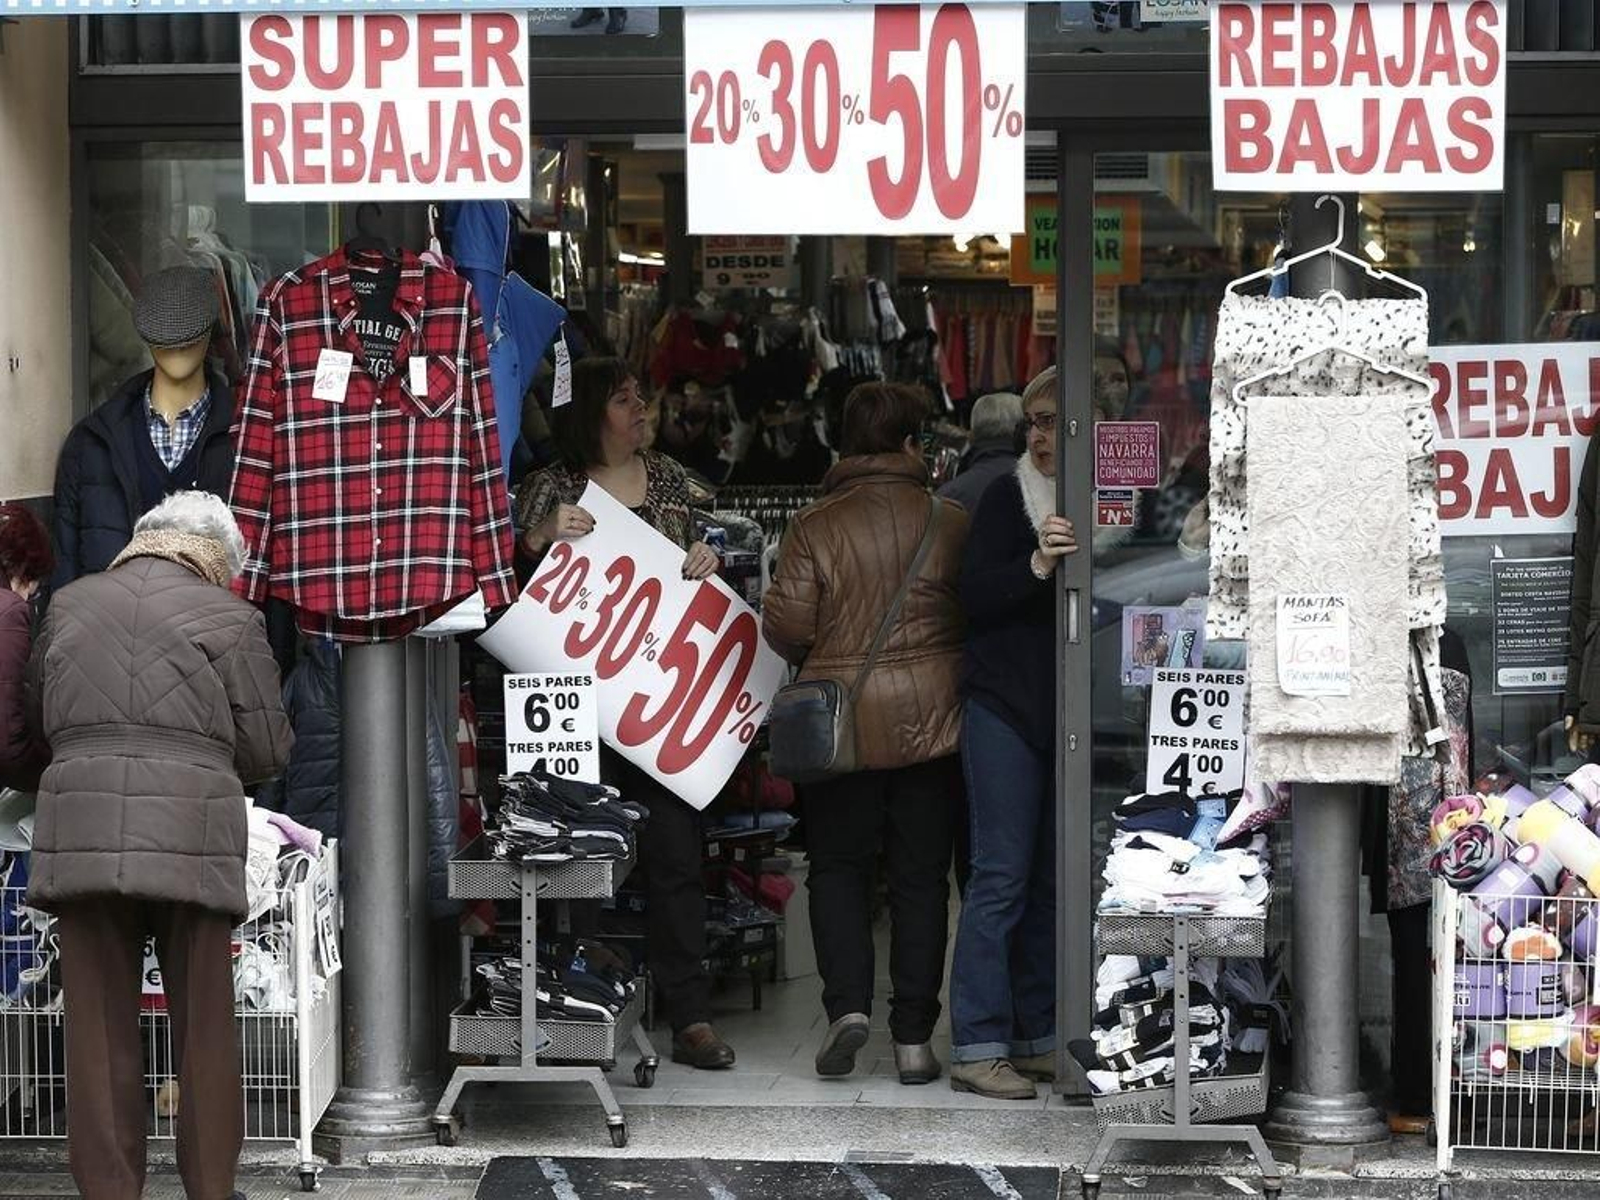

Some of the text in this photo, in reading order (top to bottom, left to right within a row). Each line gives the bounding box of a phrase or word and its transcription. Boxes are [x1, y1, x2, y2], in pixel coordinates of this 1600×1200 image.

[1218, 0, 1500, 88] REBAJAS
[249, 14, 524, 91] SUPER
[689, 4, 1023, 220] 20% 30% 50%
[251, 98, 524, 184] REBAJAS
[1224, 96, 1494, 175] BAJAS
[706, 254, 785, 269] DESDE
[385, 324, 402, 342] GE
[1105, 434, 1149, 443] IMPUESTOS
[1099, 443, 1155, 458] NAVARRA
[1099, 466, 1156, 479] COMUNIDAD
[1283, 596, 1345, 609] MANTAS
[1292, 611, 1331, 624] SOFA
[525, 542, 763, 775] 20% 30% 50%
[508, 675, 593, 689] SEIS PARES
[1157, 671, 1245, 685] SEIS PARES
[560, 717, 576, 733] €
[1207, 714, 1223, 730] €
[507, 741, 593, 753] TRES PARES
[1150, 735, 1239, 751] TRES PARES
[145, 967, 161, 986] €
